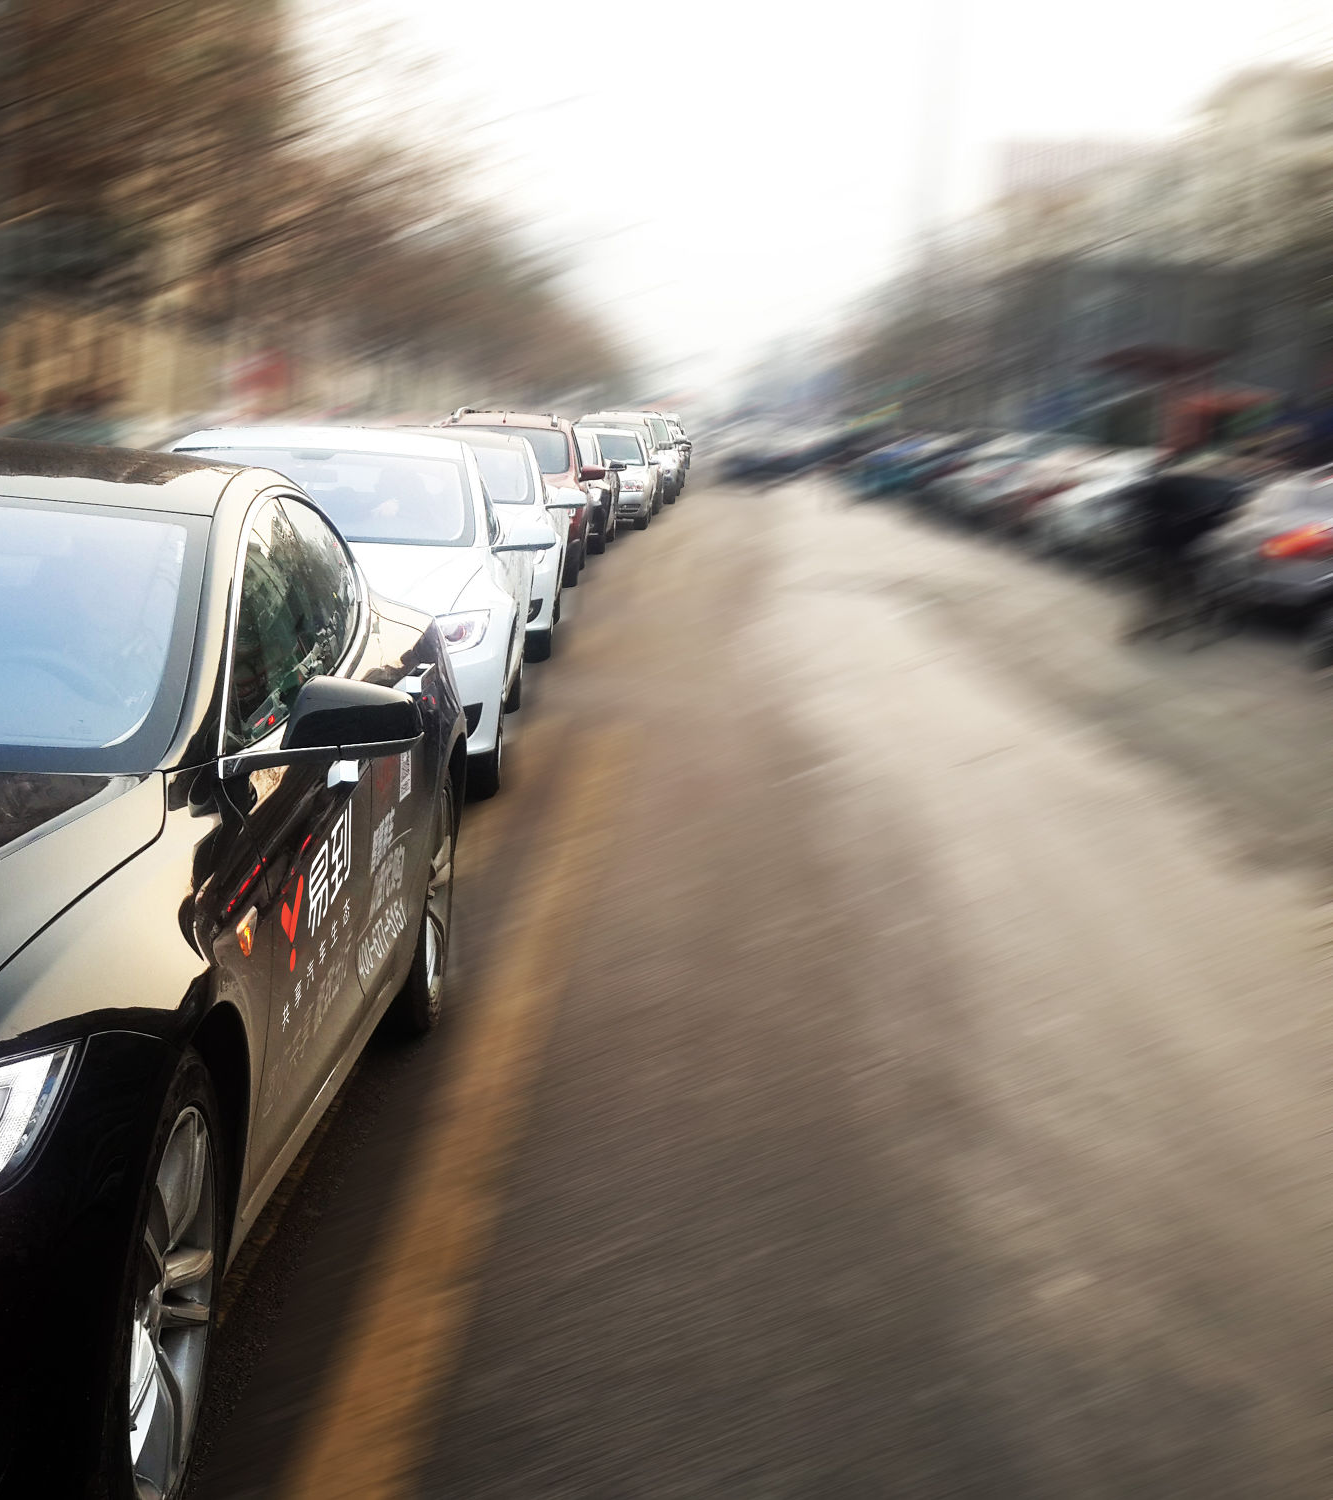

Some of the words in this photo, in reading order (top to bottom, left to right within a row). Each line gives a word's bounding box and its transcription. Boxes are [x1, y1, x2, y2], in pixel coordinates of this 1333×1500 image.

[307, 798, 352, 937] 易到
[281, 897, 351, 1033] 共享汽车生态
